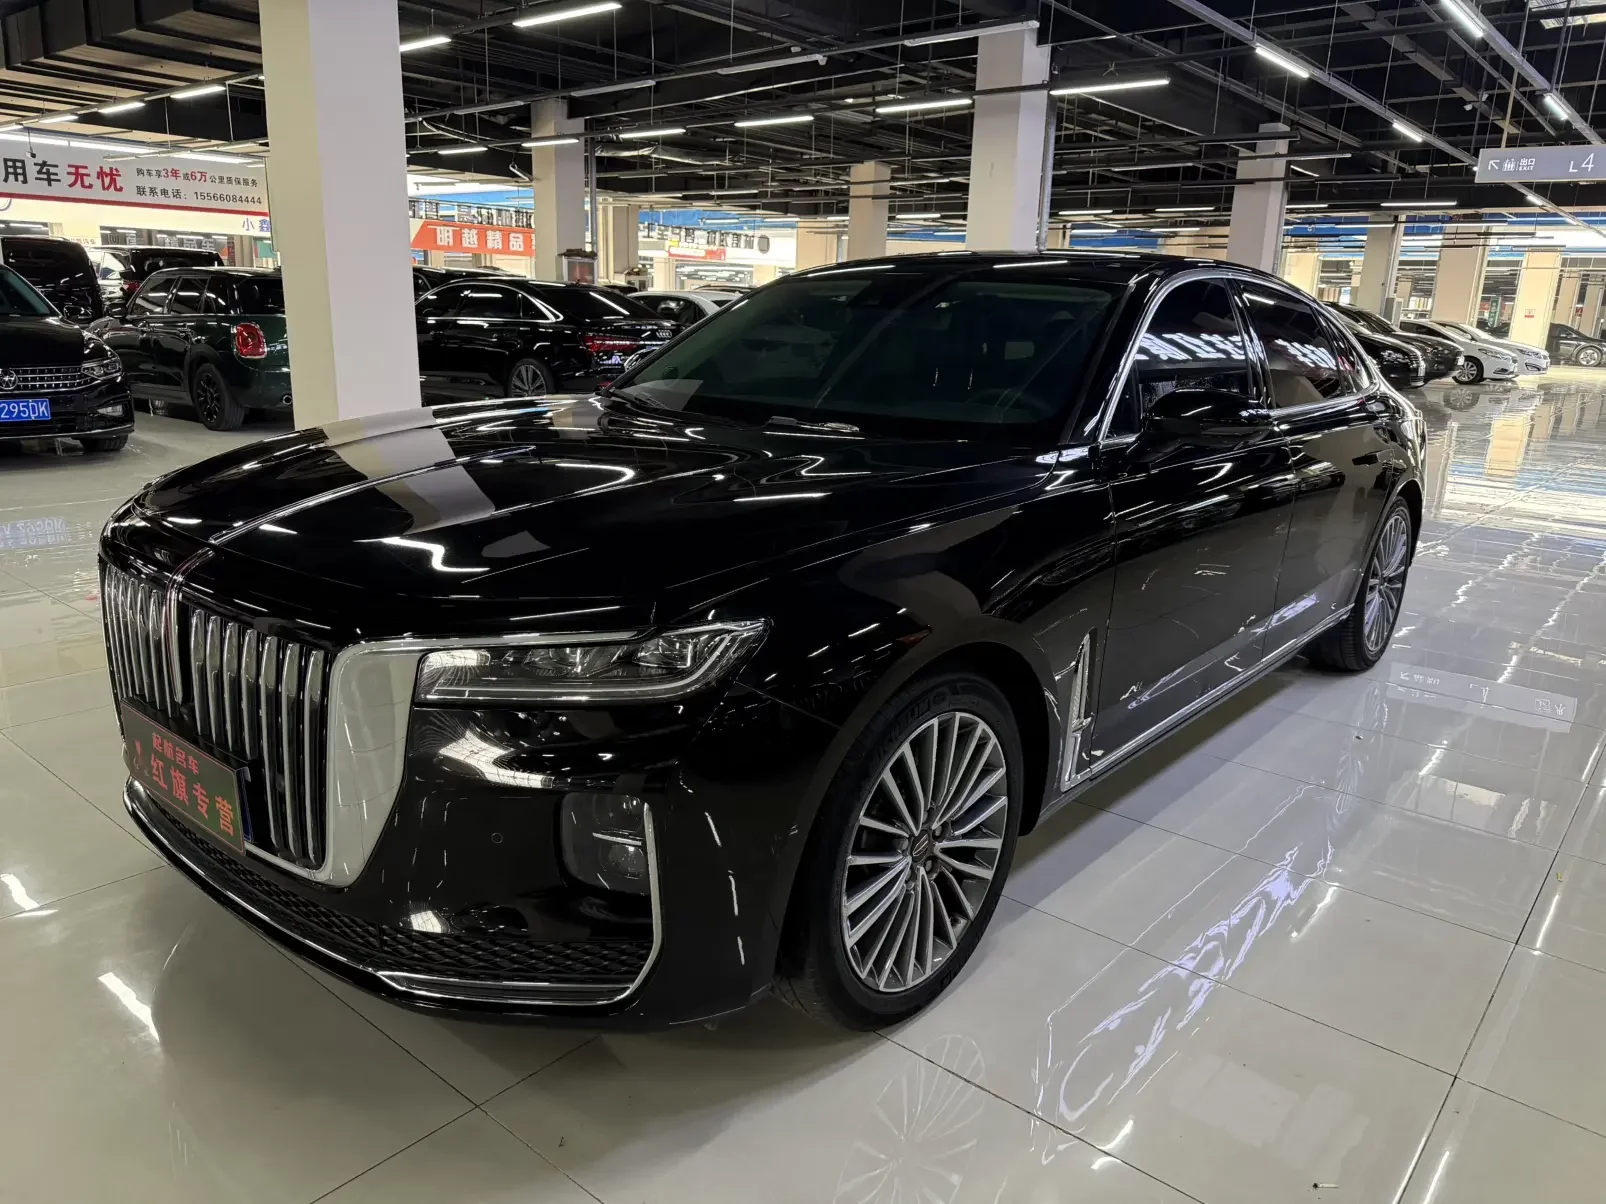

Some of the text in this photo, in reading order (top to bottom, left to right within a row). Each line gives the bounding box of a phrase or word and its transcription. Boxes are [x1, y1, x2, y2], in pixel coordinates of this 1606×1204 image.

[3, 157, 124, 192] 用车无忧
[0, 402, 48, 418] 295DK
[151, 754, 234, 836] 红旗专营
